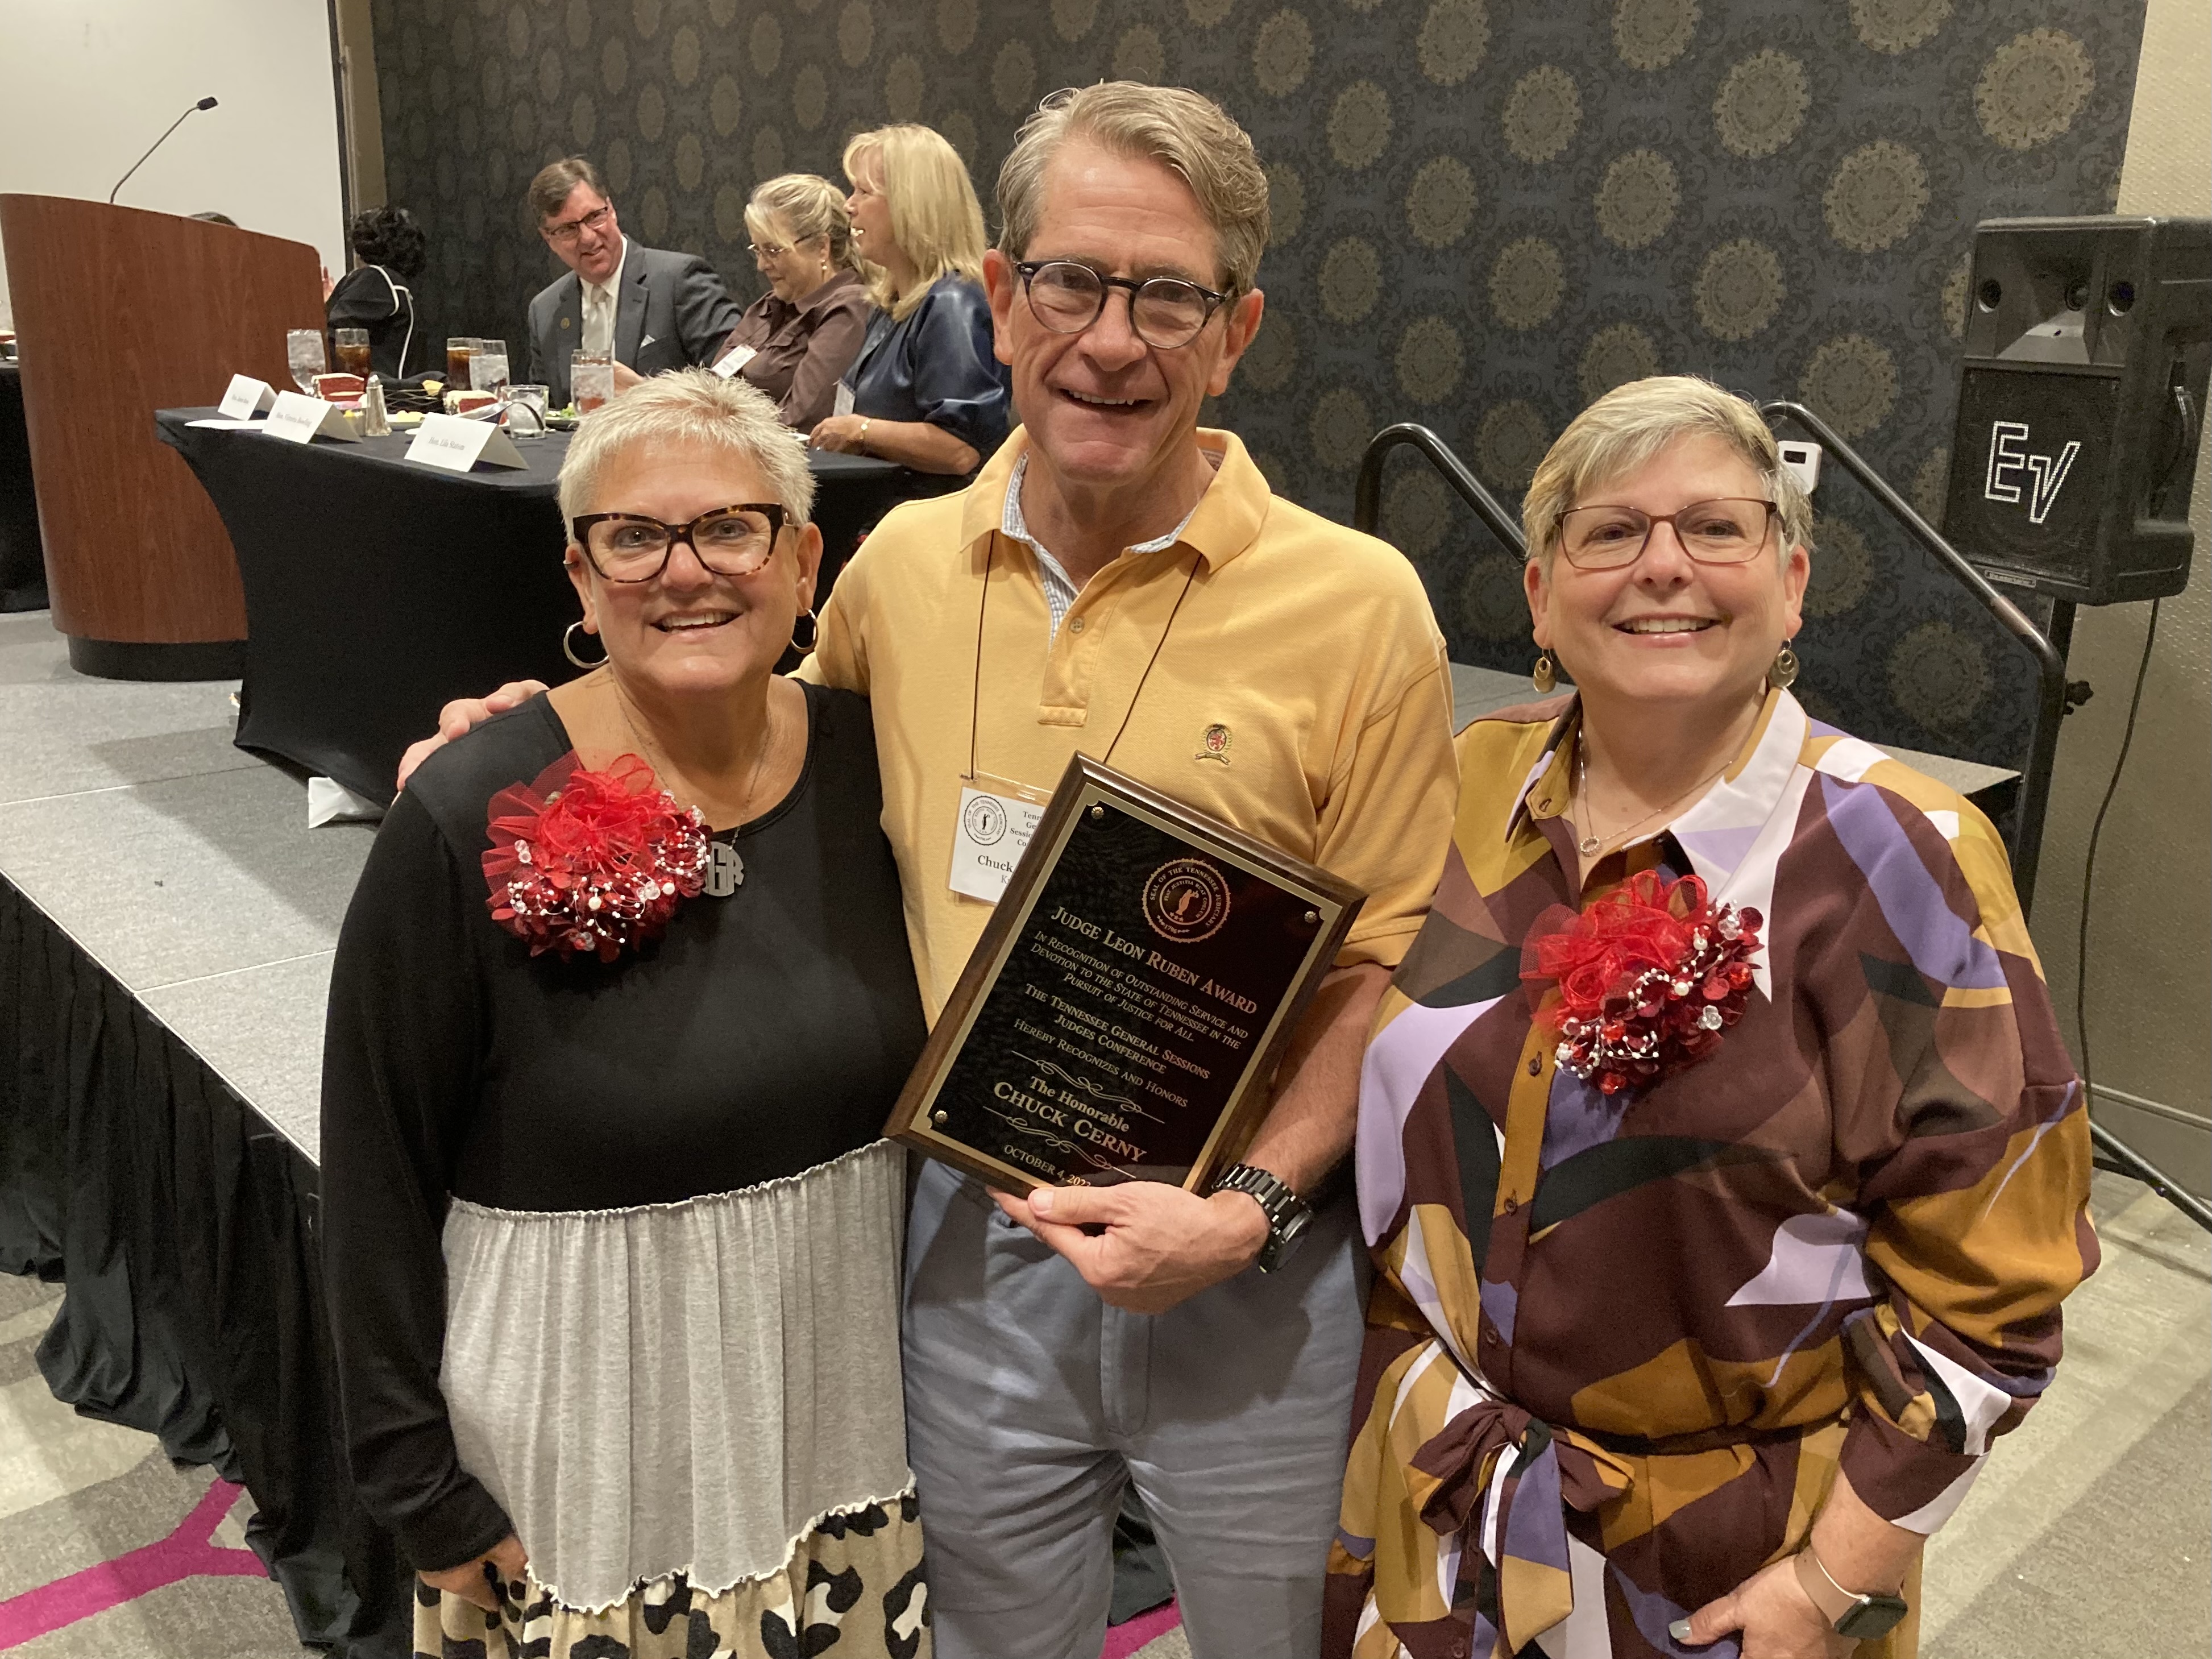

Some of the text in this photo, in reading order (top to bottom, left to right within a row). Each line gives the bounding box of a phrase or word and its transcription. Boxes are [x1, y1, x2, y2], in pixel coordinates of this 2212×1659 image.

[978, 855, 1014, 873] Chuck
[1150, 867, 1222, 927] SEAL OF THE TENNESSEE JUDICIARY
[1034, 931, 1248, 1039] IN RECOGNITION OF OUTSTANDING SERVICE AND
[1051, 906, 1258, 1014] JUDGE LEON RUBEN AWARD
[1024, 983, 1210, 1079] THE TENNESSEE GENERAL SESSIONS
[1030, 943, 1242, 1050] DEVOTION TO THE STATE OF TENNESSEE IN THE
[1063, 972, 1104, 997] PURSUIT
[1104, 993, 1118, 1003] OF
[1118, 999, 1155, 1022] JUSTICE
[1155, 1017, 1174, 1032] FOR
[1013, 1018, 1188, 1107] HEREBY RECOGNIZES AND HONORS
[1054, 1014, 1167, 1074] JUDGES CONFERENCE
[994, 1081, 1147, 1162] CHUCK CERNY
[1030, 1076, 1130, 1132] The Honorable
[1004, 1144, 1056, 1176] OCTOBER
[1057, 1169, 1065, 1181] 4,
